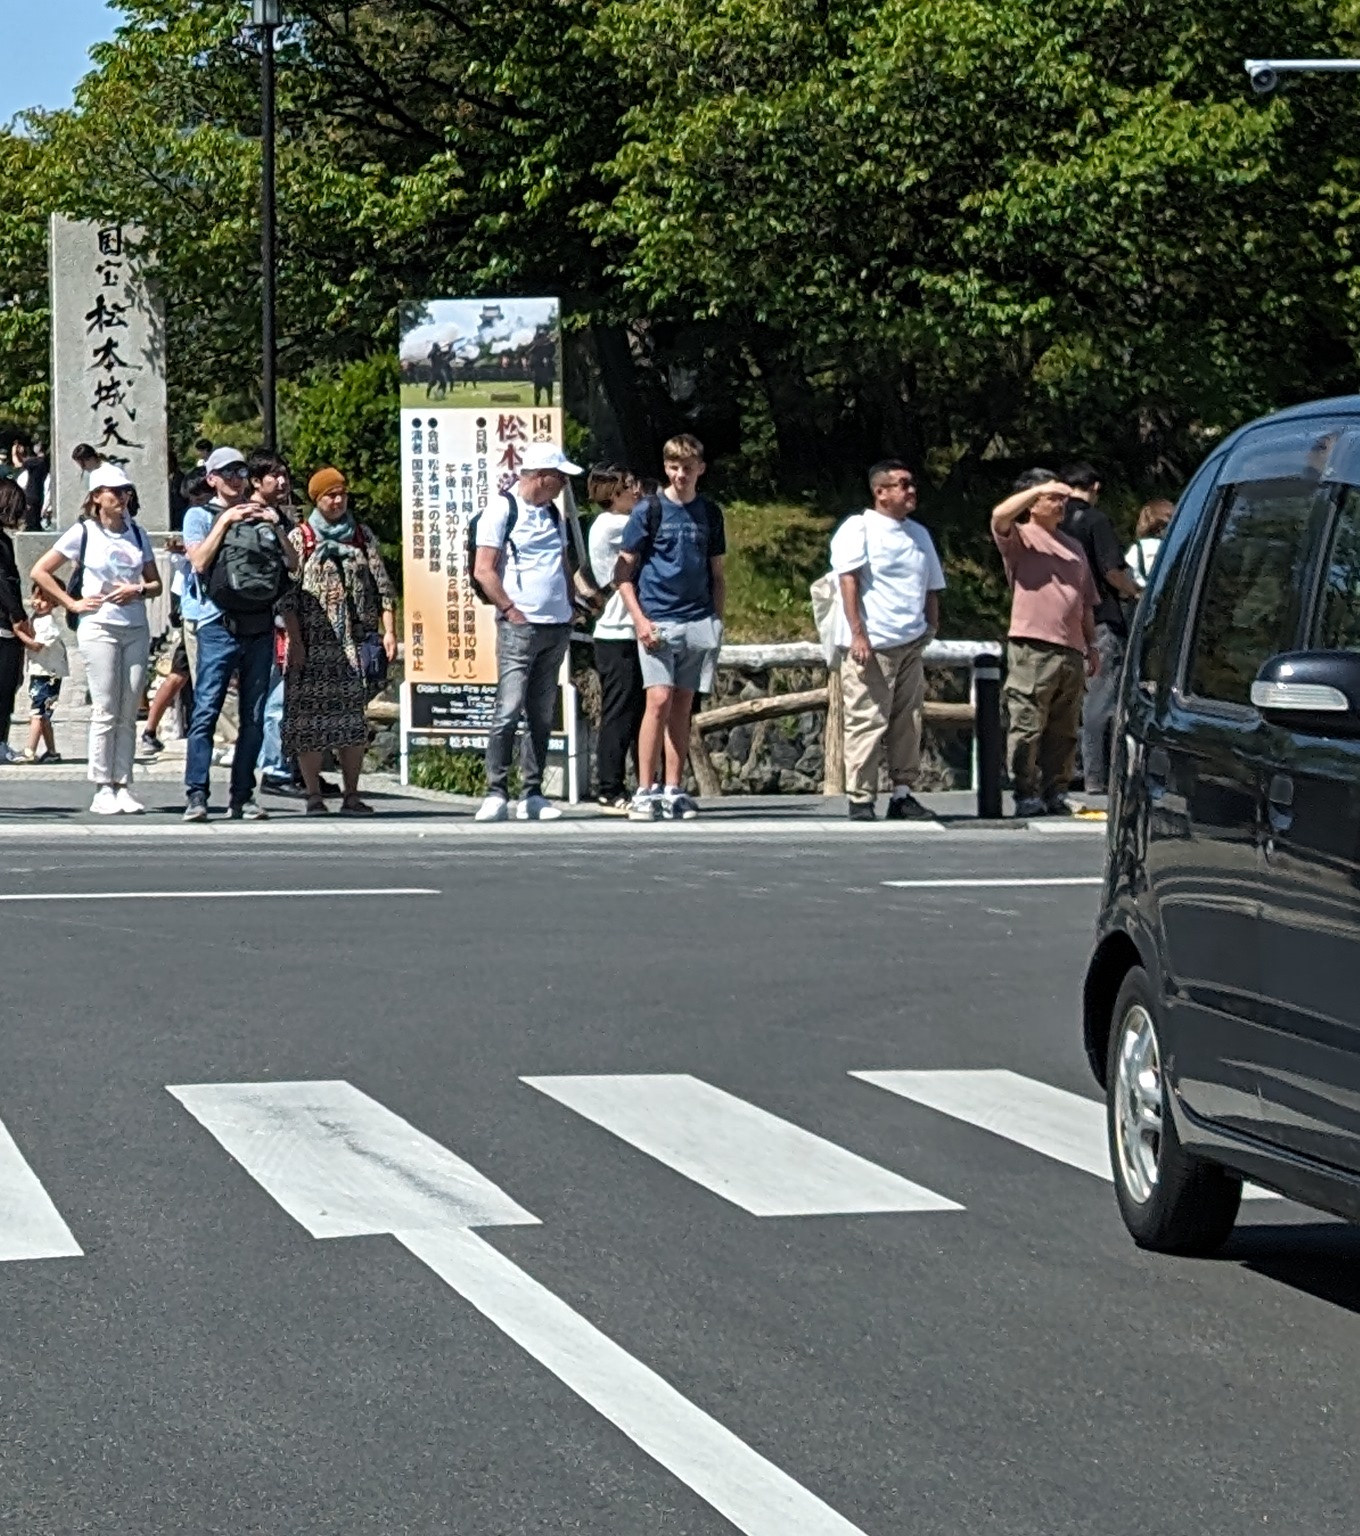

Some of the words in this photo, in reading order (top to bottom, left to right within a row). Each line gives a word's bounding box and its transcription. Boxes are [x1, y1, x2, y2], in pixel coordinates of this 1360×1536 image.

[84, 226, 145, 464] 国宝松本城天
